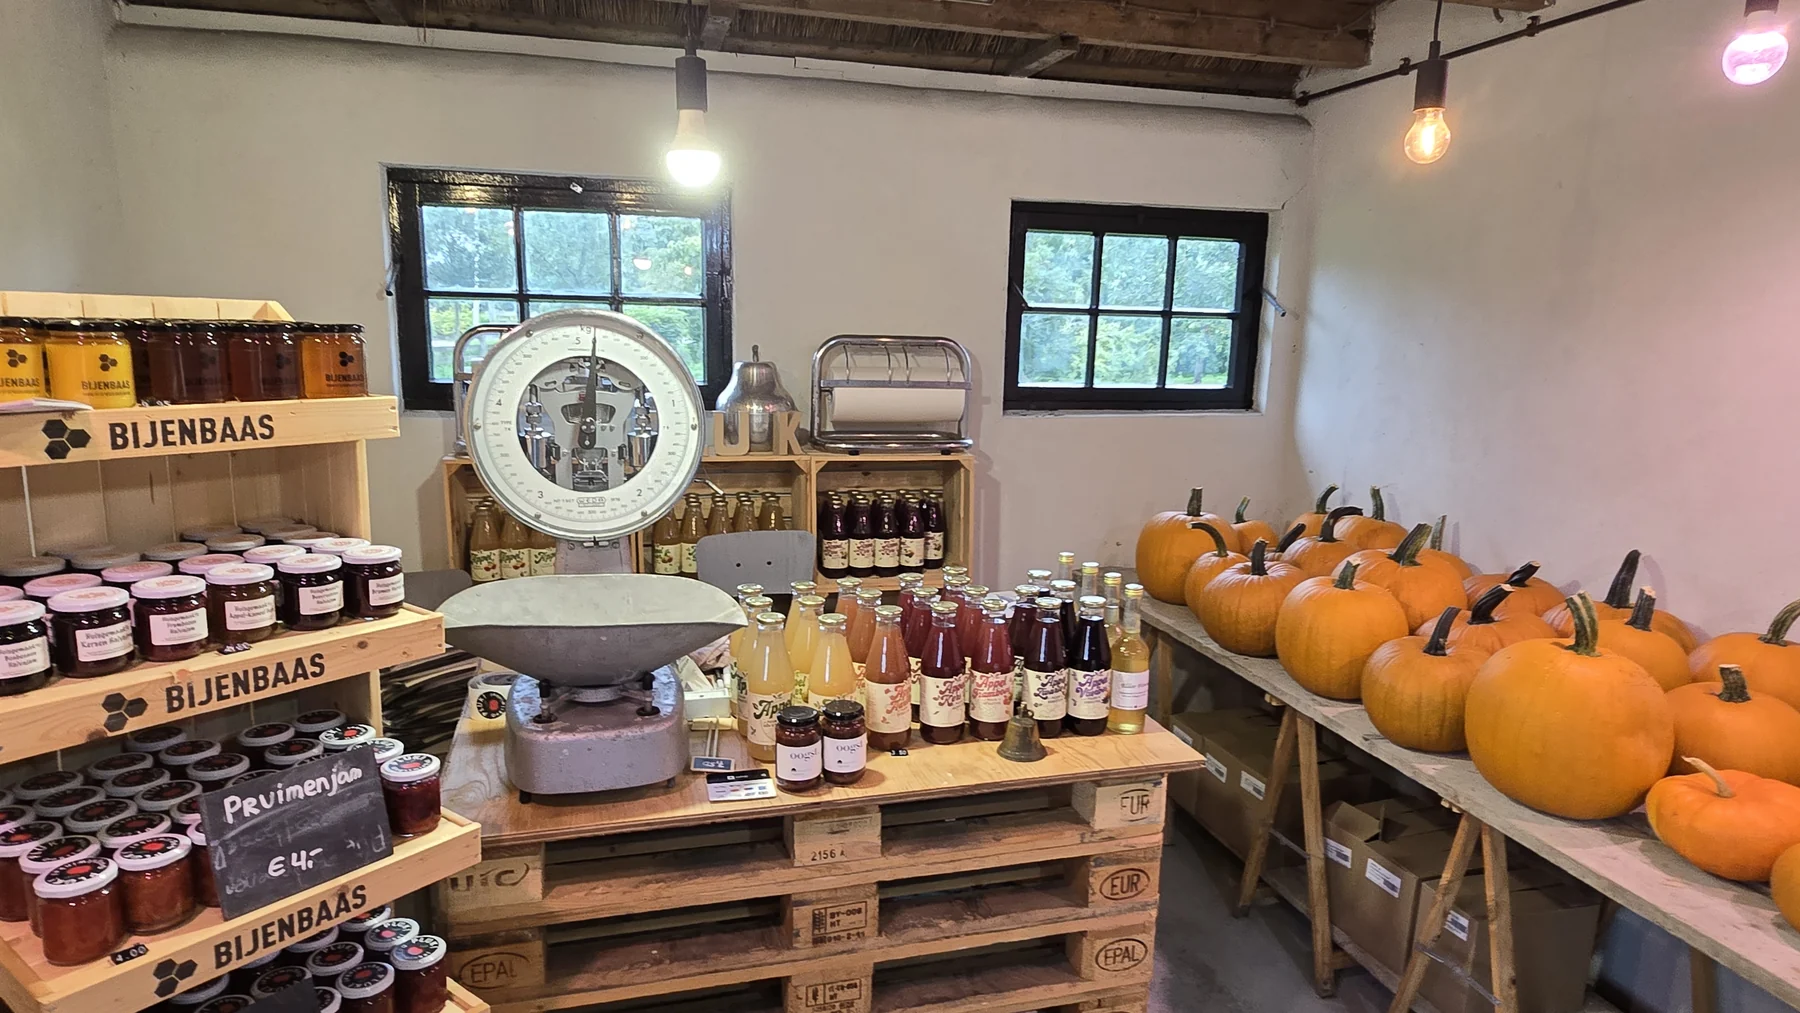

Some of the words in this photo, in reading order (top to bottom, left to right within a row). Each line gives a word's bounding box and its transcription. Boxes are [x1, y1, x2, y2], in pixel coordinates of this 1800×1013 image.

[580, 324, 592, 334] kg
[574, 336, 582, 345] 5
[81, 380, 130, 391] BIJENBAAS
[496, 398, 502, 406] 4
[672, 399, 676, 408] 1
[108, 414, 275, 451] BIJENBAAS
[537, 490, 544, 499] 3
[636, 488, 642, 496] 2
[165, 653, 326, 714] BIJENBAAS
[976, 675, 1008, 692] Appel
[811, 848, 836, 862] 2156
[1110, 872, 1141, 896] EUR
[214, 884, 367, 970] BIJENBAAS
[1104, 946, 1140, 966] EPAL
[470, 960, 518, 984] EPAL
